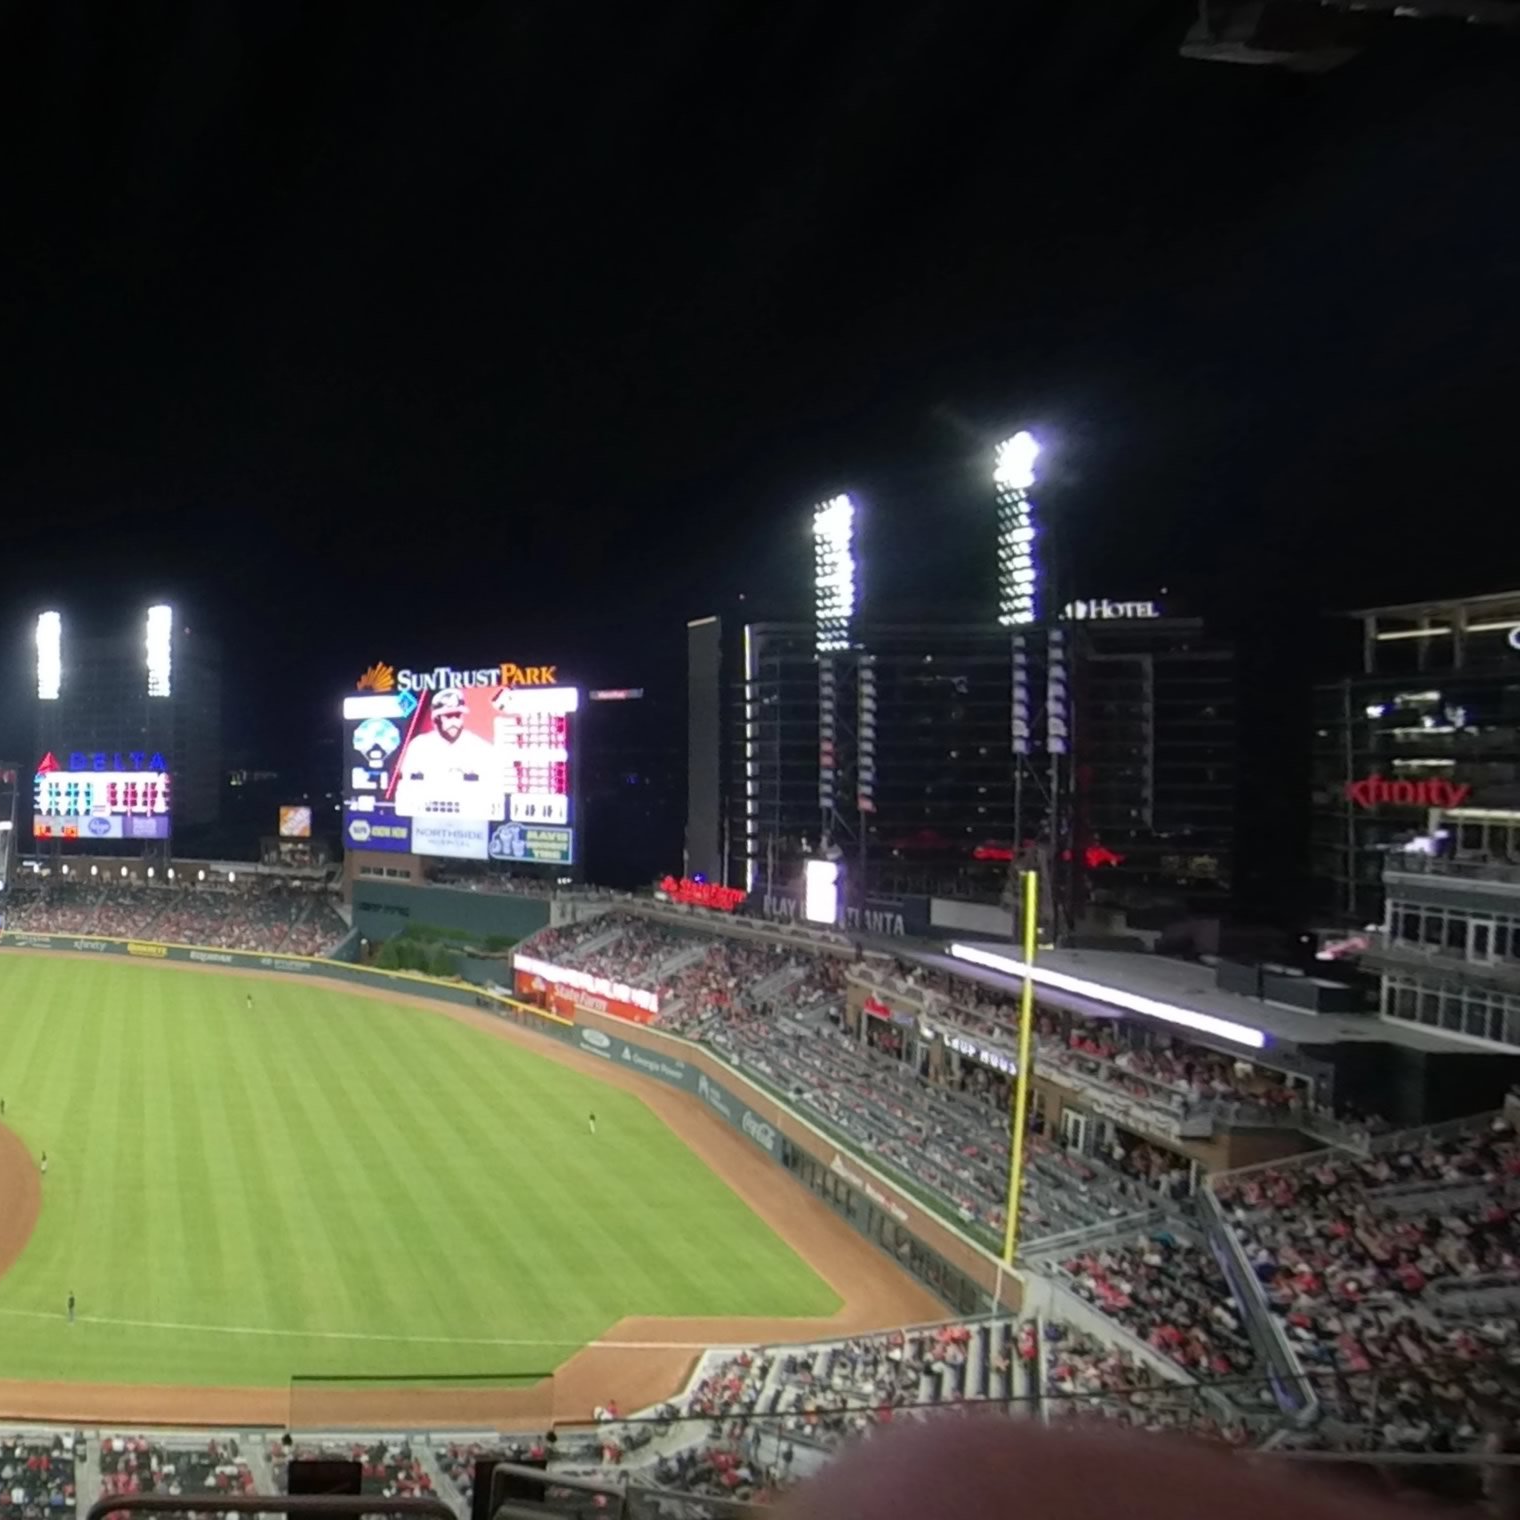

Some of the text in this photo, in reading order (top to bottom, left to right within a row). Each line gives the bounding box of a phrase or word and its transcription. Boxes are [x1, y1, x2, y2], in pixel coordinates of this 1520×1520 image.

[1088, 599, 1160, 619] HOTEL
[69, 751, 169, 771] DELTA
[1346, 773, 1471, 808] xfinity
[415, 827, 484, 840] NORTHSIDE
